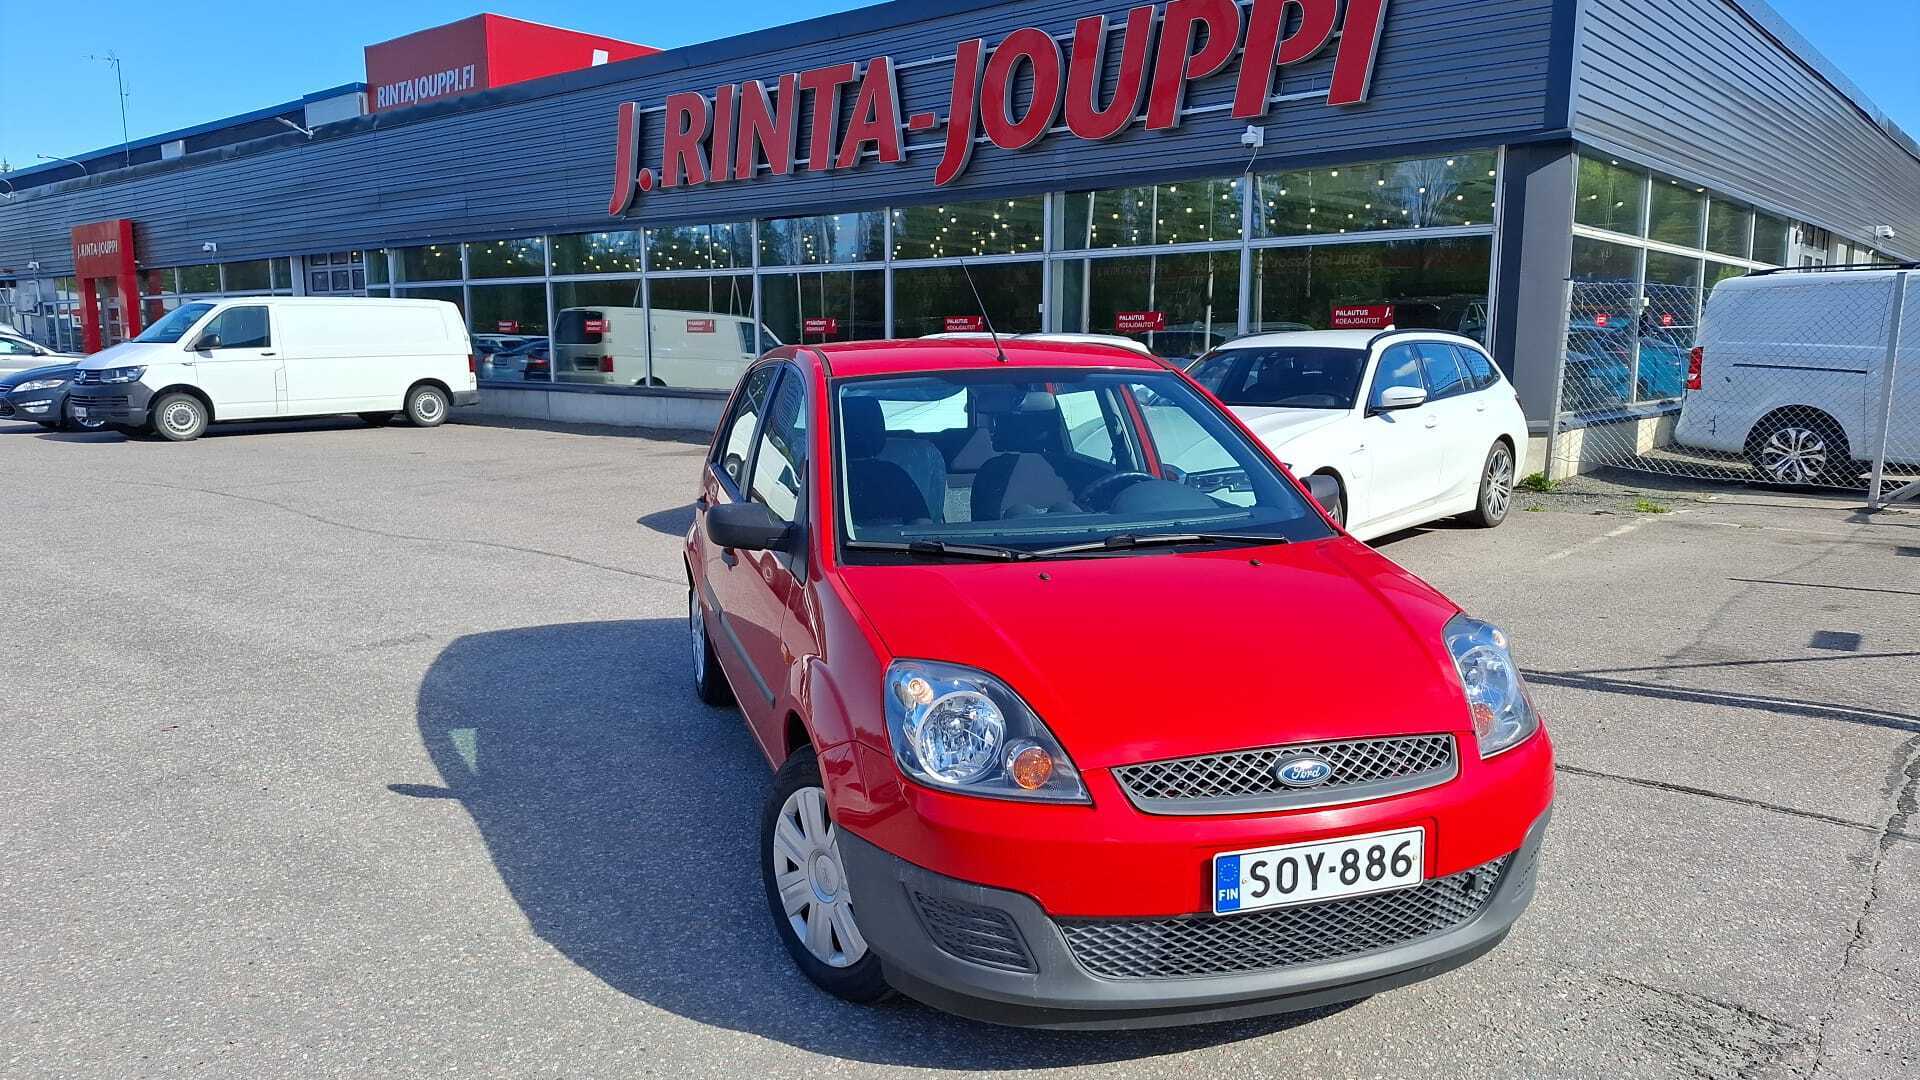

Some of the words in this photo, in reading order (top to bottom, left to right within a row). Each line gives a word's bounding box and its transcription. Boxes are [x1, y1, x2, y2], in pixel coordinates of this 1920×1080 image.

[377, 64, 475, 108] RINTAJOUPPI.FI
[1335, 317, 1381, 325] KOEAJOAUTOT
[1290, 766, 1321, 779] Ford
[1250, 839, 1412, 898] SOY-886
[1218, 887, 1239, 901] FIN
